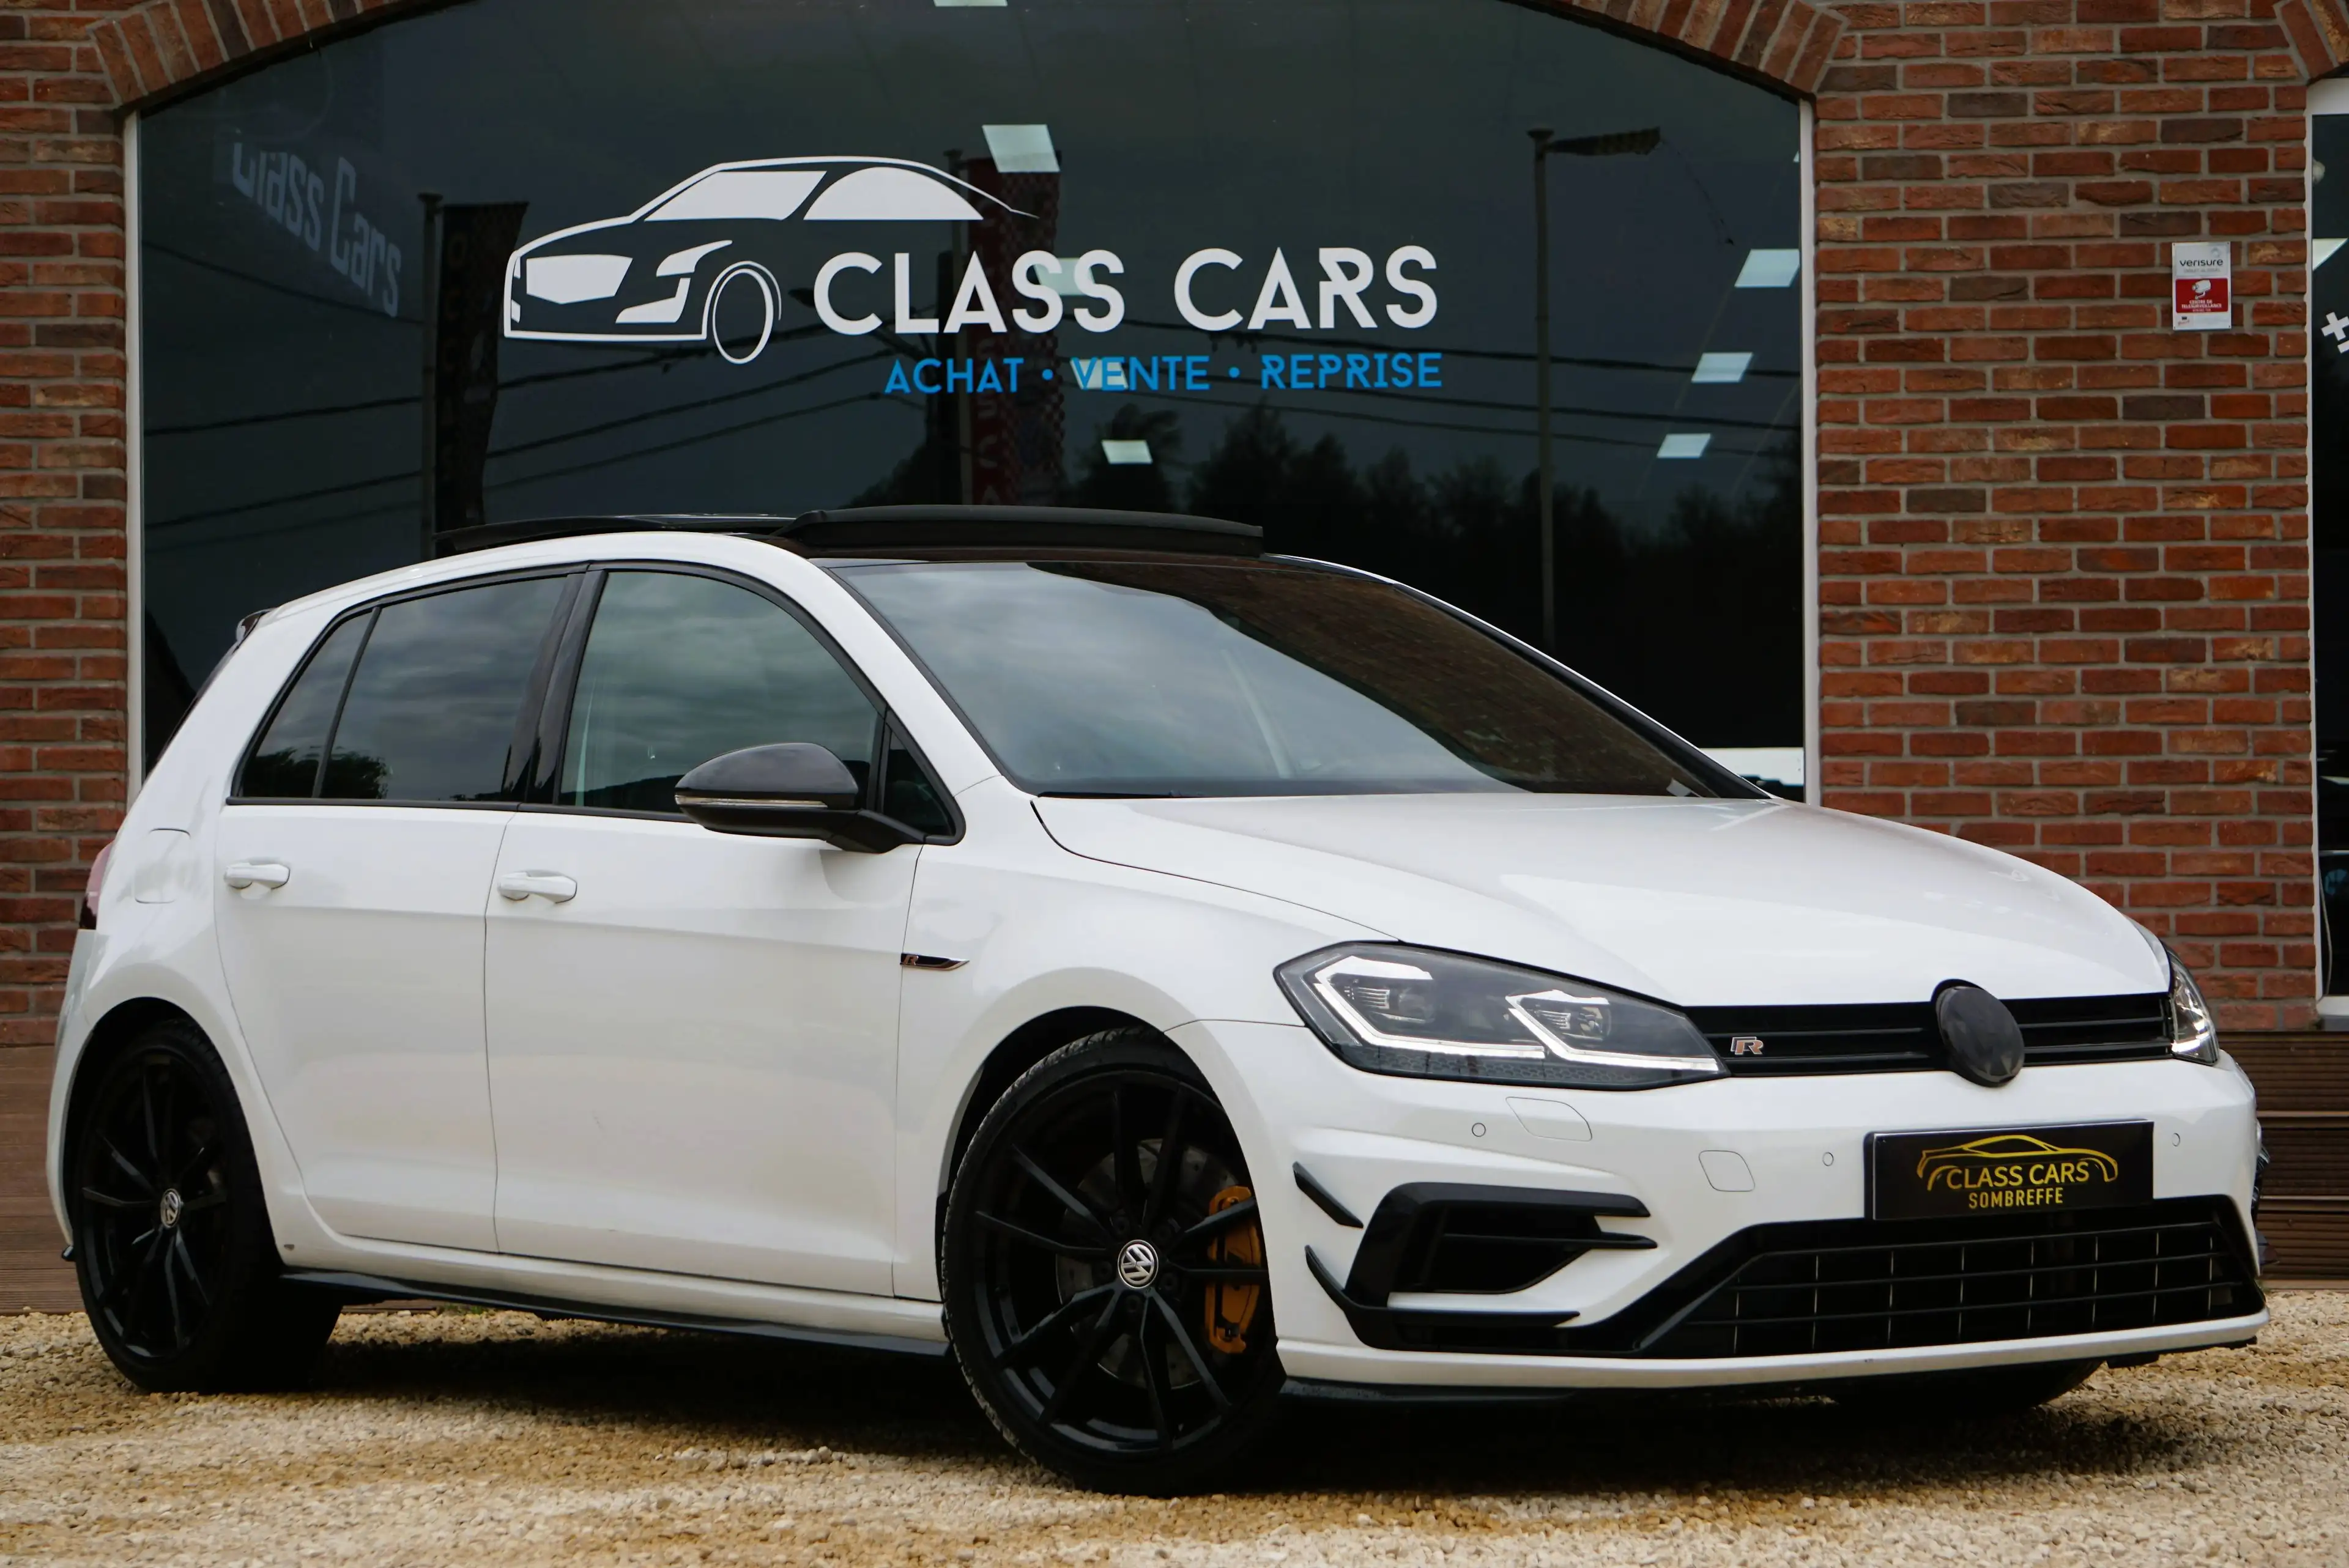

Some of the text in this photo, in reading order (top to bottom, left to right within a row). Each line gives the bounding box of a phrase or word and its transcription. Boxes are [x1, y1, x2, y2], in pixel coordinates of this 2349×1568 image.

[330, 157, 401, 317] Cars
[814, 245, 1437, 335] CLASS CARS
[885, 352, 1442, 394] ACHAT VENTE REPRISE
[1731, 1037, 1764, 1055] R
[1946, 1161, 2090, 1189] CLASS CARS
[1969, 1187, 2063, 1209] SOMBREFFE
